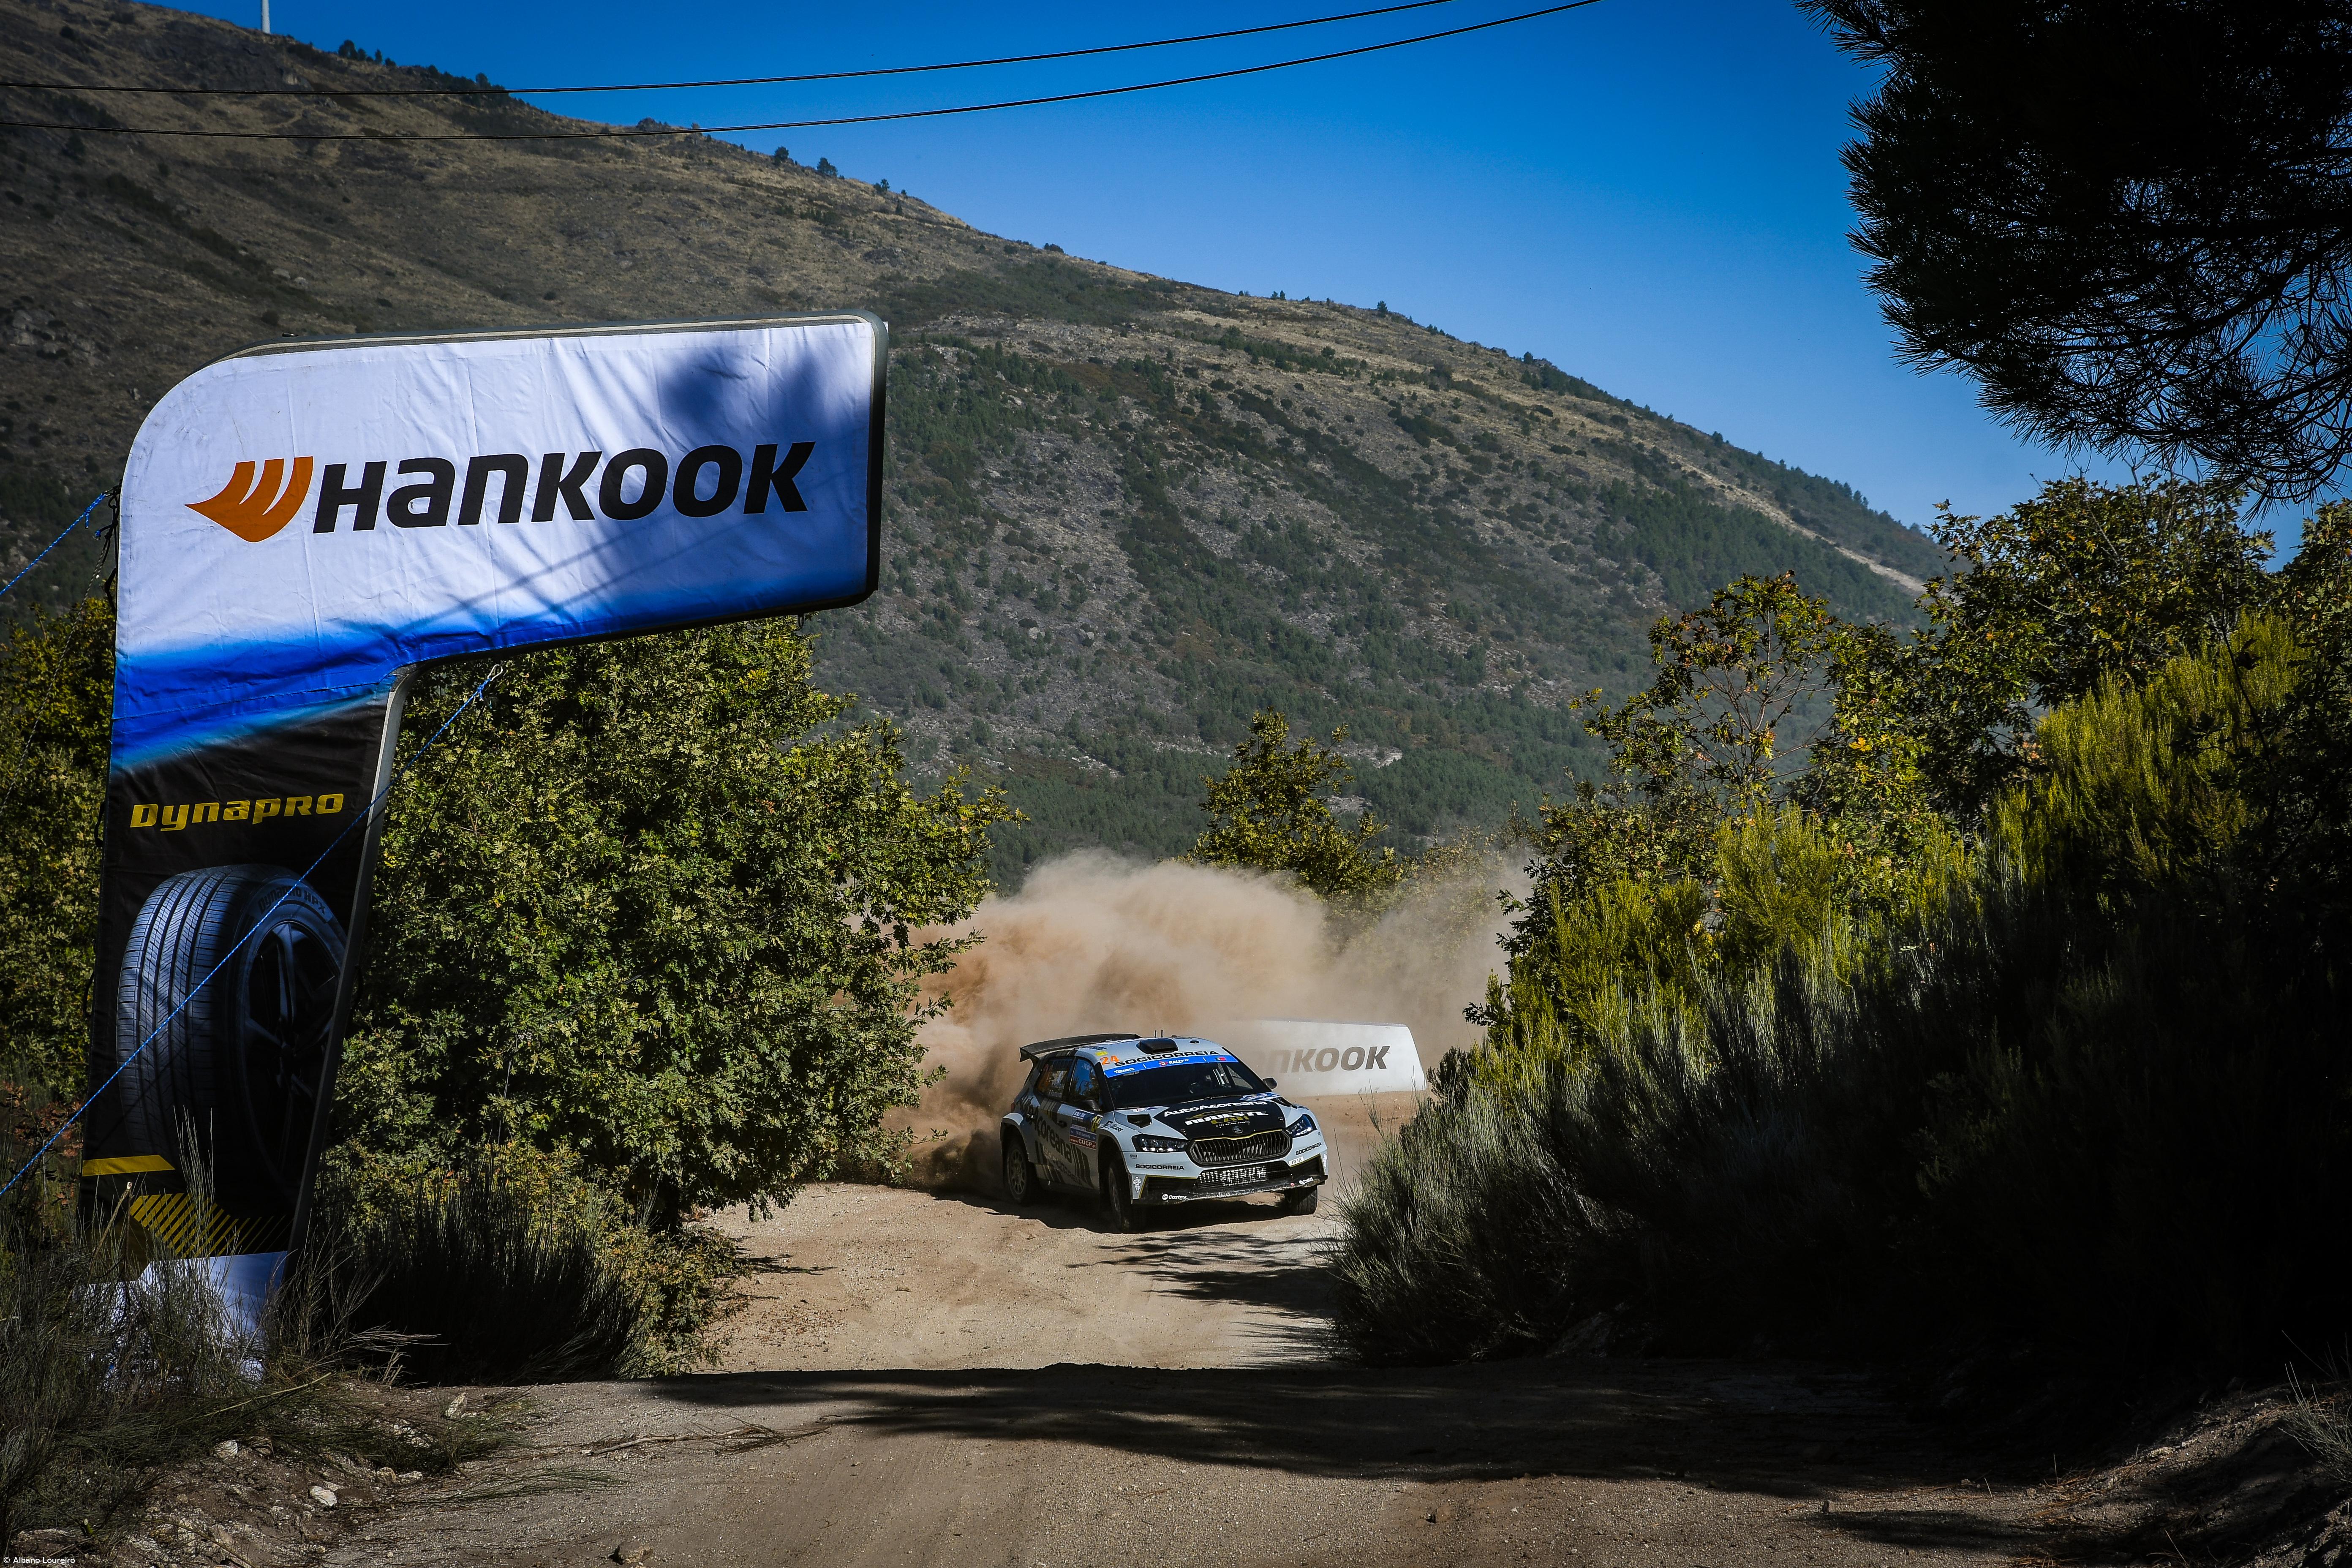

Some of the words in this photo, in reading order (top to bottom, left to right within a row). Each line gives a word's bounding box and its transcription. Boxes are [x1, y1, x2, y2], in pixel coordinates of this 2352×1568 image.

[1100, 1055, 1119, 1065] 24
[1114, 1051, 1220, 1067] SOCICORREIA
[1266, 1046, 1390, 1074] NKOOK
[1296, 1142, 1321, 1155] SOCICORREIA
